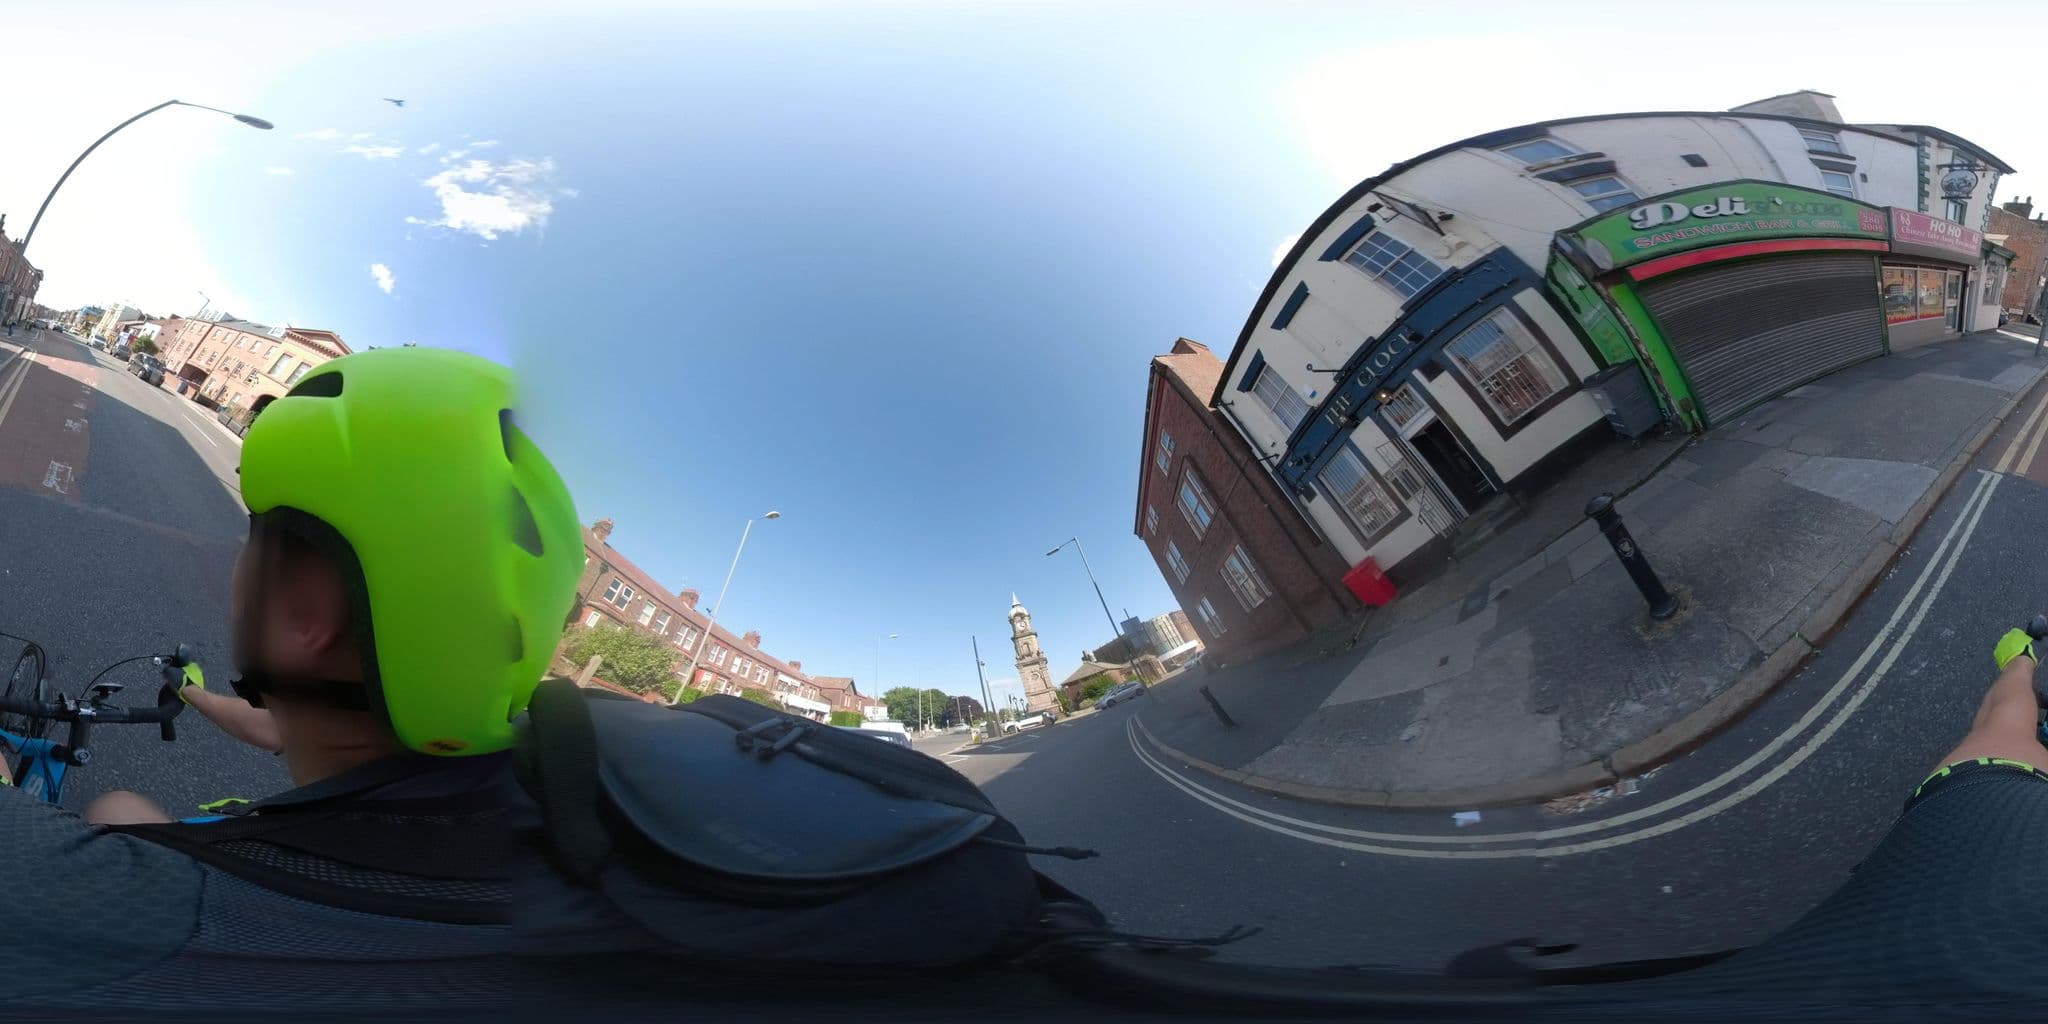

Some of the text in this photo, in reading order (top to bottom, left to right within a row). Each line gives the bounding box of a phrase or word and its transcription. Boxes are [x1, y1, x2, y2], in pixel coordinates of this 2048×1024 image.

[1634, 221, 1753, 248] SANDWICH
[1755, 218, 1793, 230] BAR
[1929, 219, 1962, 238] HO HO
[1324, 391, 1352, 425] THE
